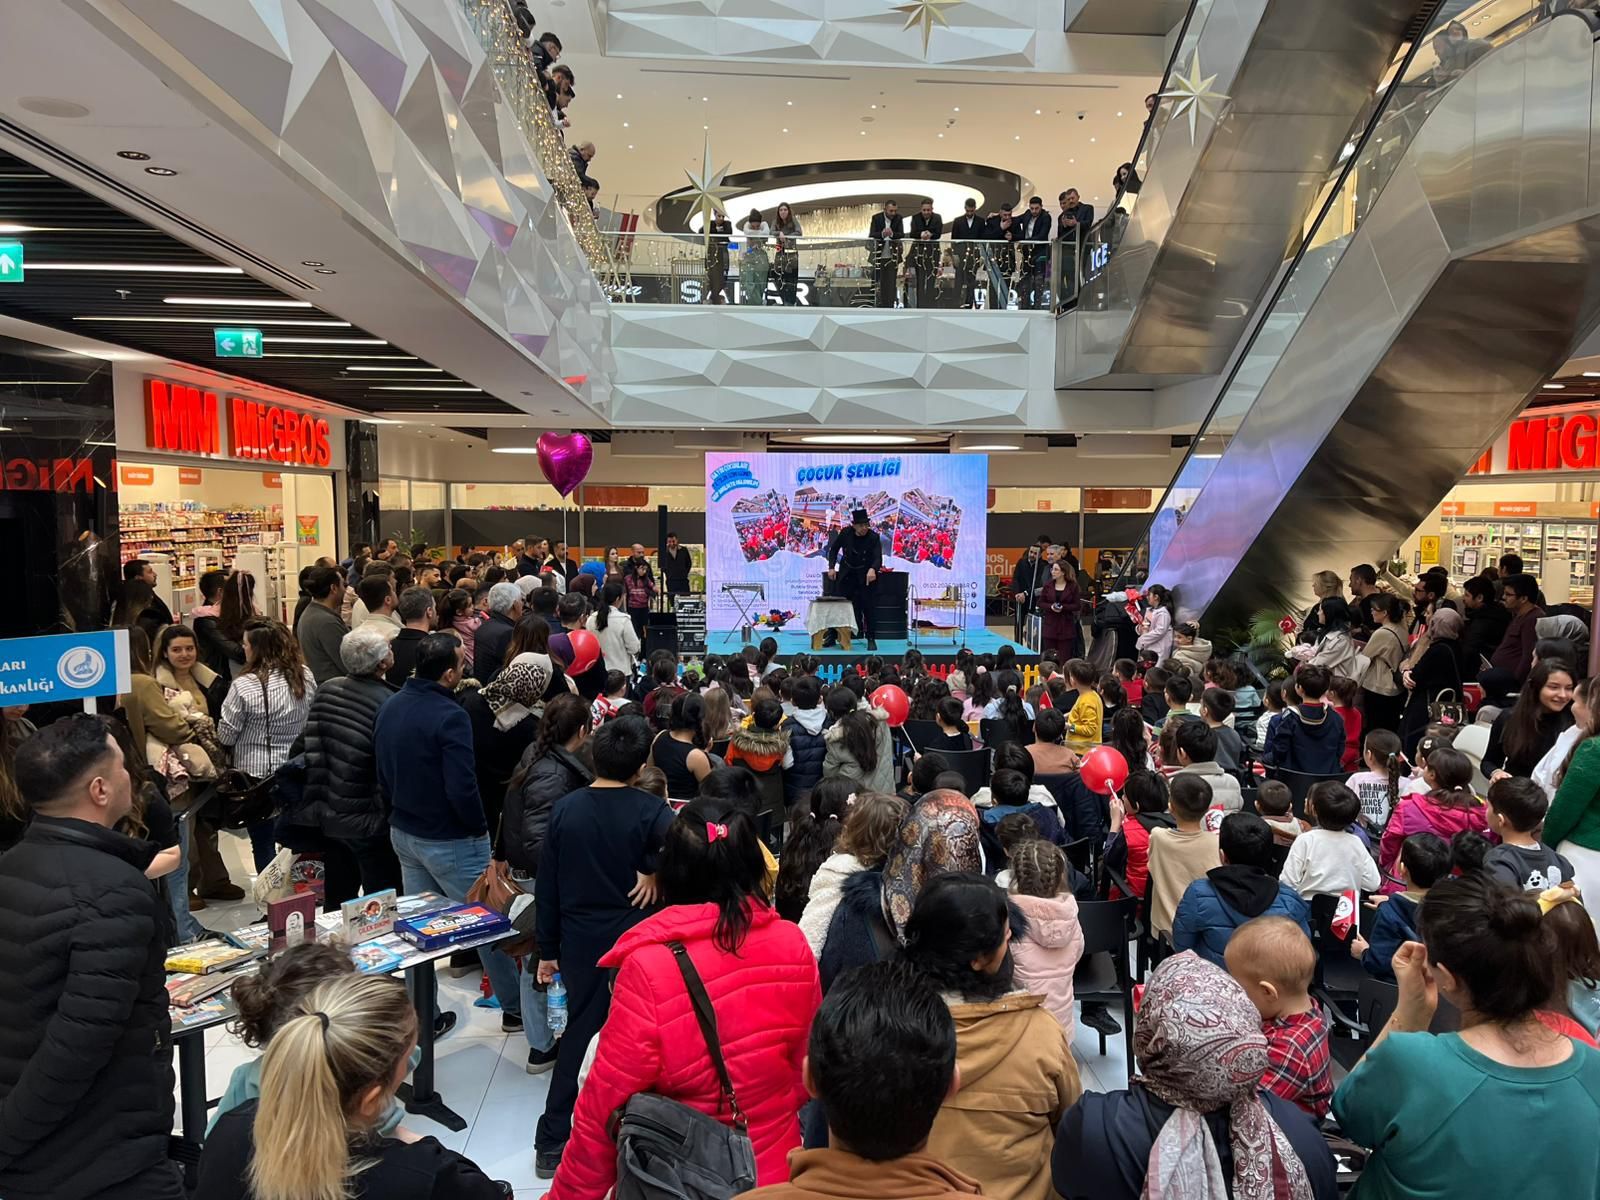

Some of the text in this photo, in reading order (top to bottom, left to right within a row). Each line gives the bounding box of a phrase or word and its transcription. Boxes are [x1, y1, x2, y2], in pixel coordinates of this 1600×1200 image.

[145, 380, 220, 454] MM
[1508, 415, 1600, 471] MiG
[797, 465, 844, 485] ÇOCUK
[1359, 783, 1372, 791] YOU
